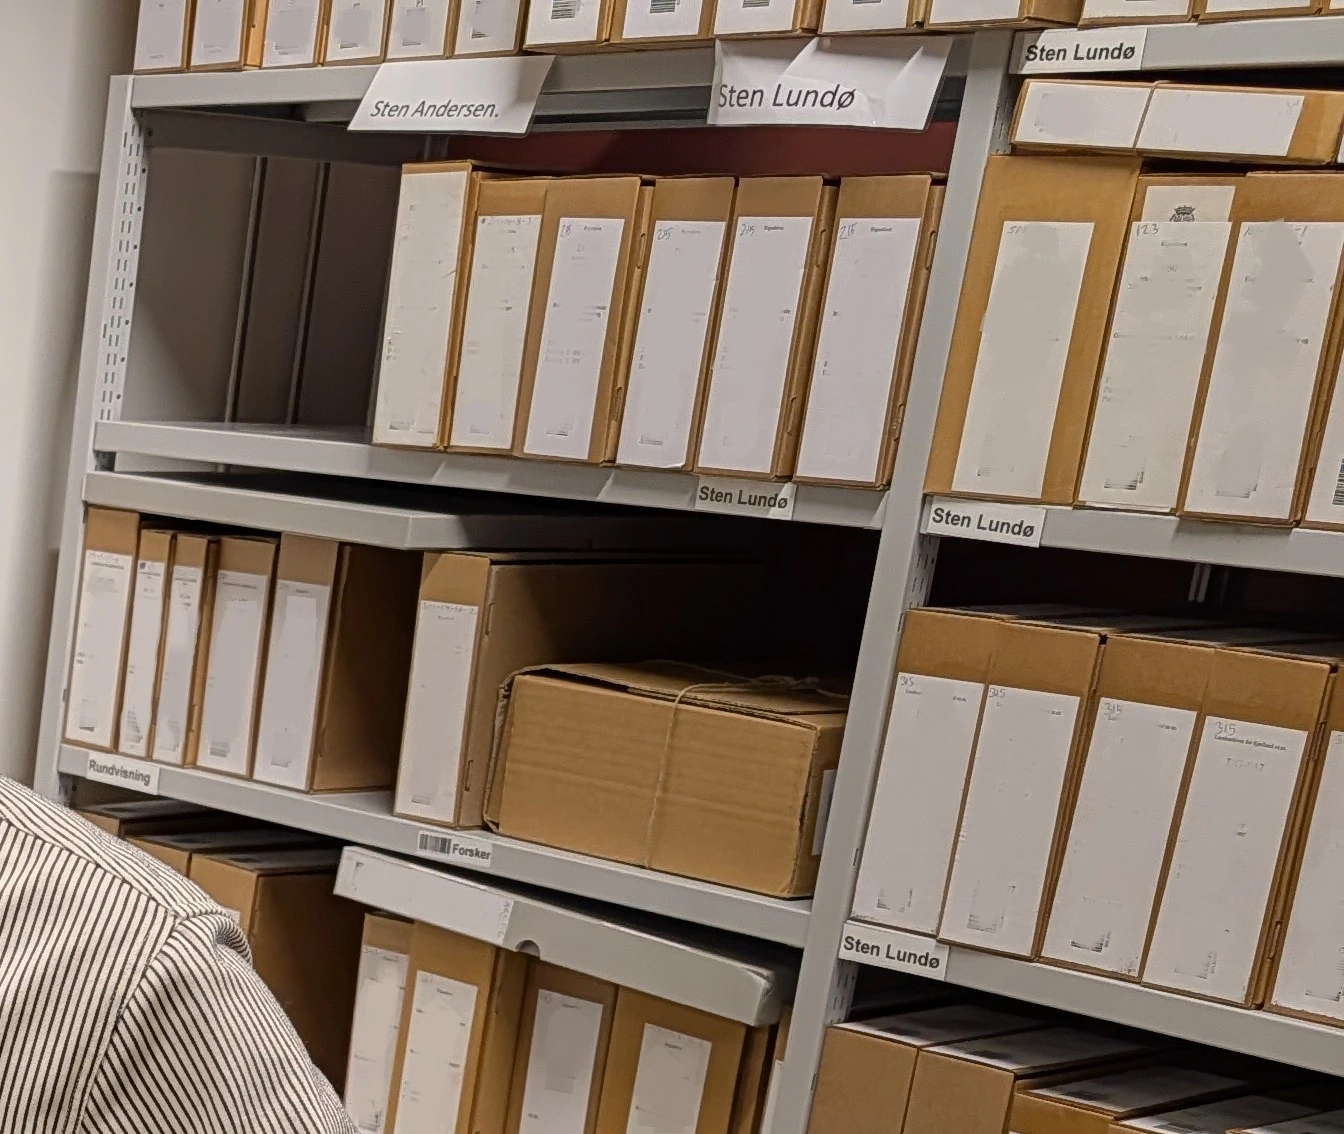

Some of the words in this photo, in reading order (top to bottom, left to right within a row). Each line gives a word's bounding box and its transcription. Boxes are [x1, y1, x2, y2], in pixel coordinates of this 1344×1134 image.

[1025, 44, 1068, 61] Sten
[1073, 42, 1136, 60] Lundø
[370, 100, 410, 118] Sten
[411, 99, 499, 118] Andersen.
[718, 83, 764, 108] Sten
[772, 83, 856, 111] Lundø
[699, 486, 733, 503] Sten
[737, 489, 788, 509] Lundø
[932, 507, 972, 528] Sten
[976, 513, 1035, 537] Lundø
[89, 759, 151, 787] Rundvisning
[452, 843, 491, 860] Forsker
[843, 935, 881, 957] Sten
[885, 944, 940, 968] Lundø
